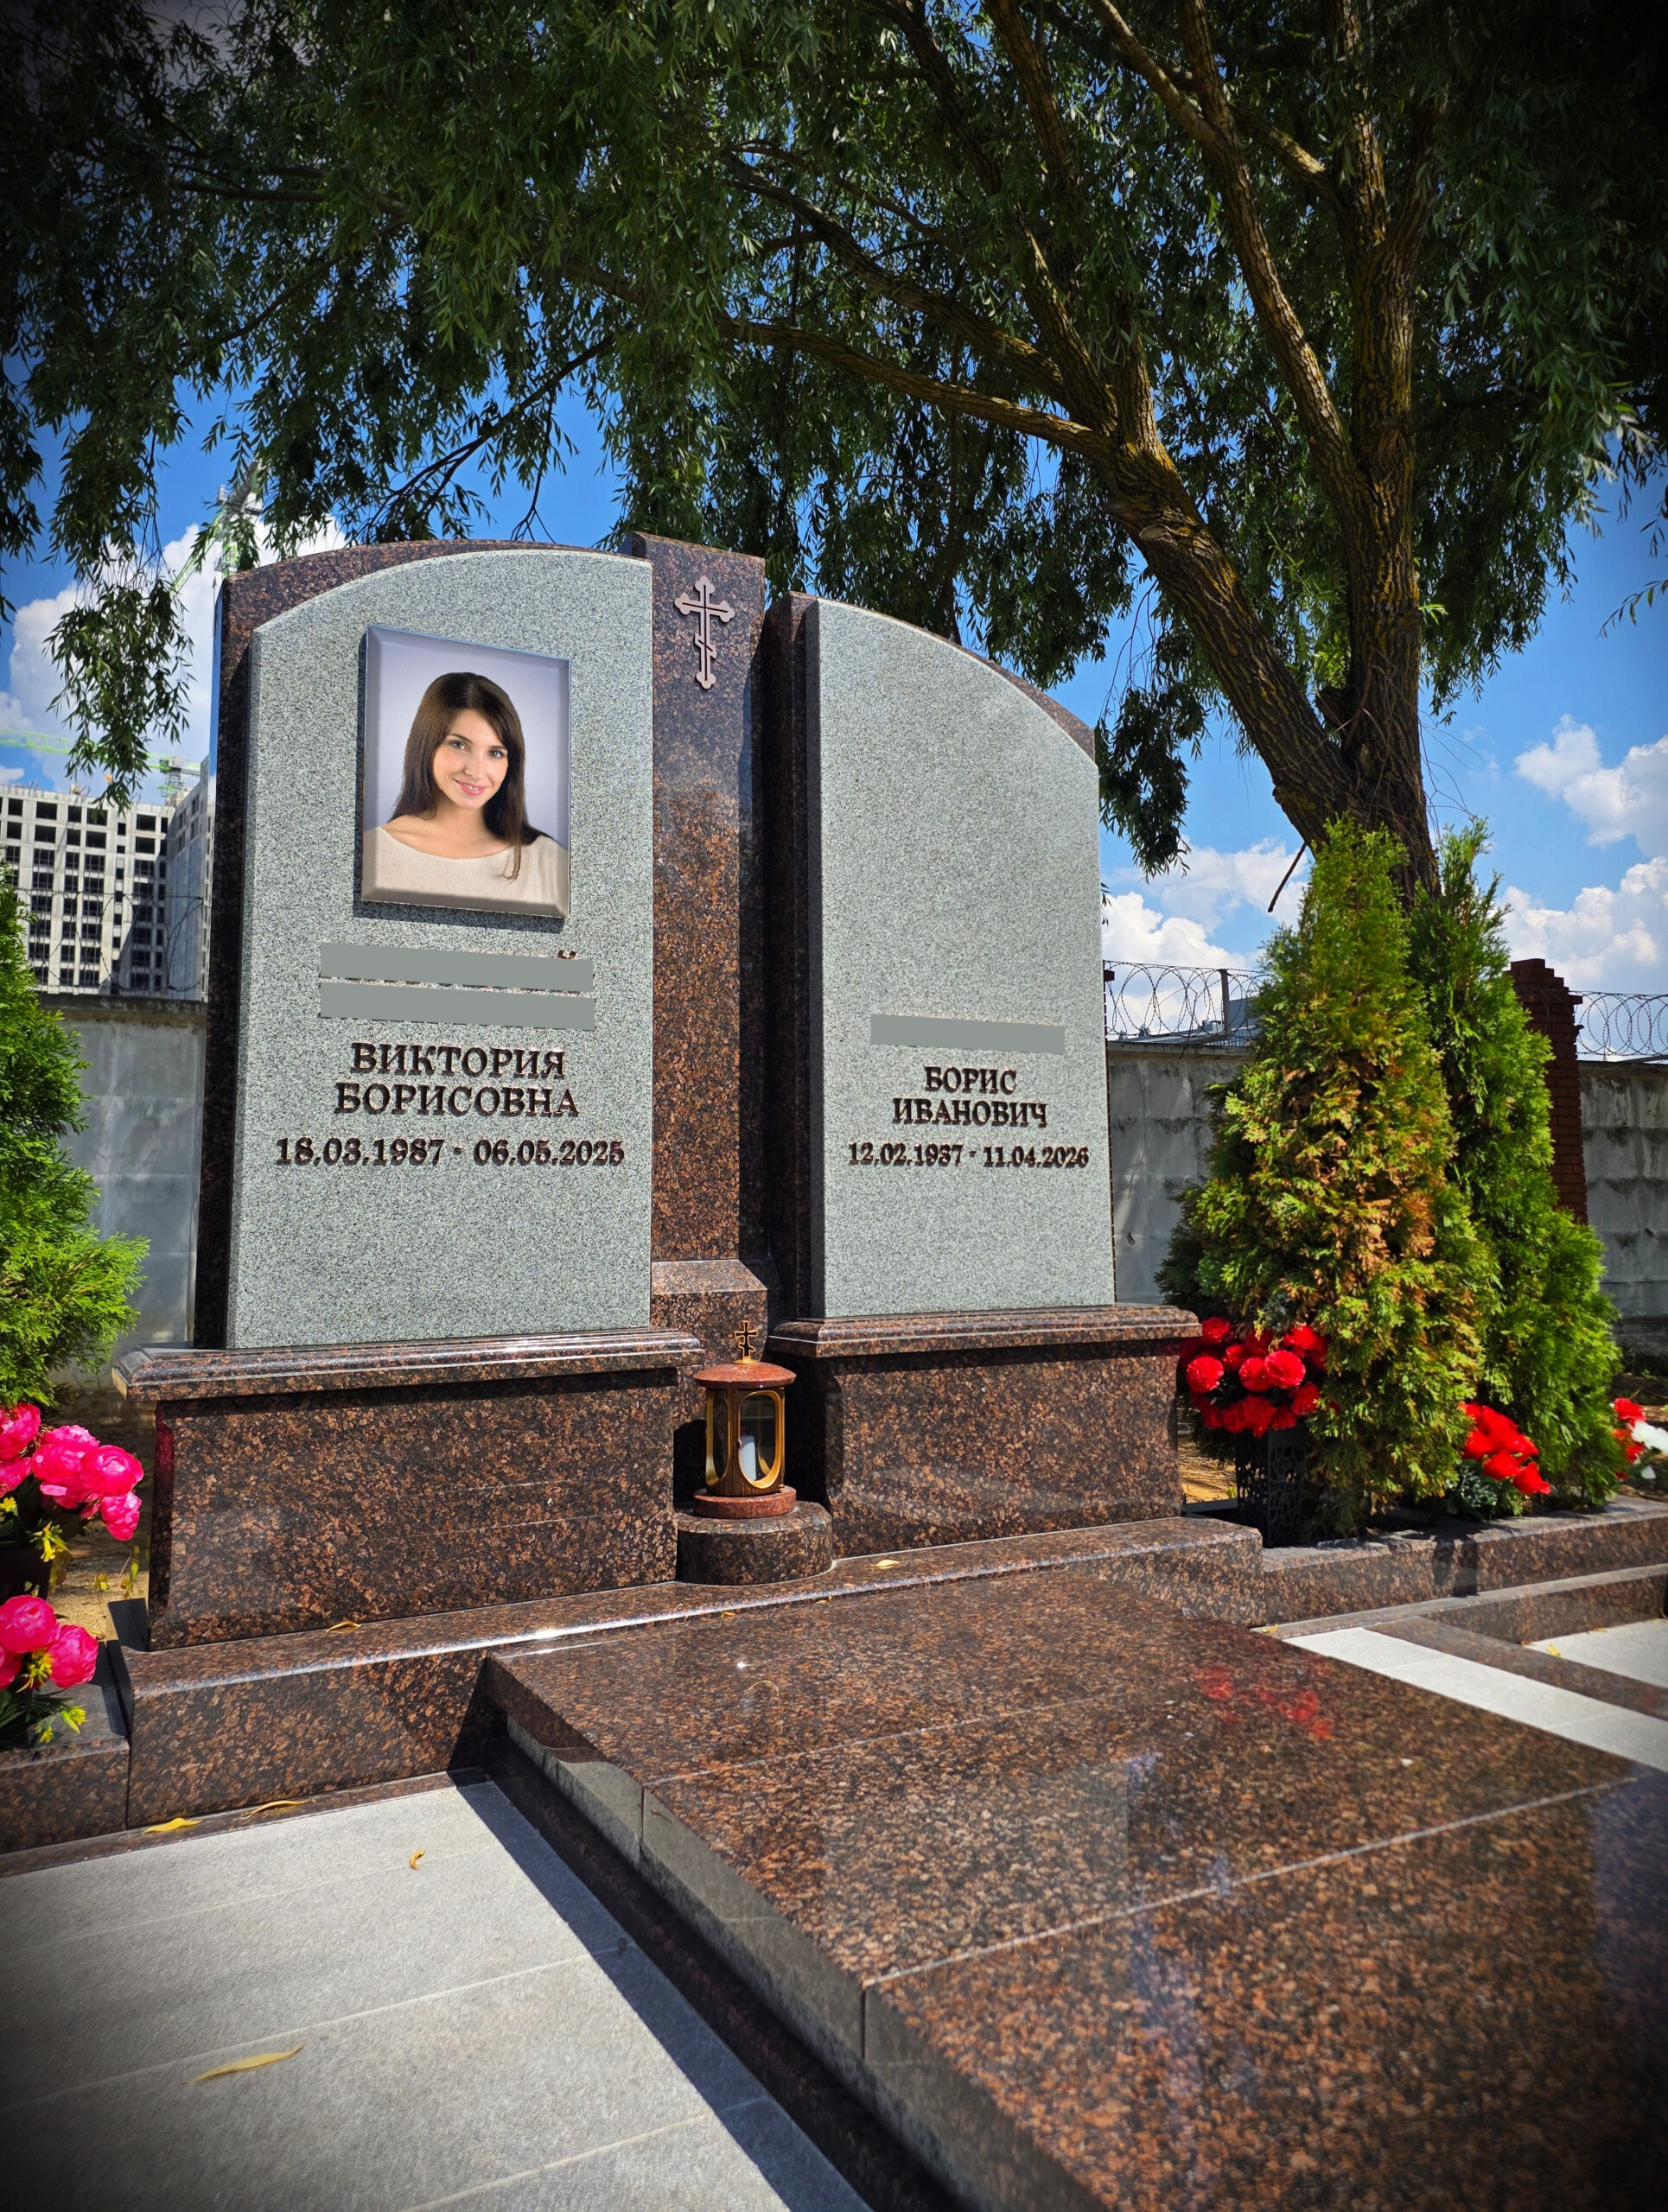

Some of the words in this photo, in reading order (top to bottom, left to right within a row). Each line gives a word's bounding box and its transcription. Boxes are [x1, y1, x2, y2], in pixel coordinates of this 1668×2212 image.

[350, 1041, 567, 1079] ВИКТОРИЯ
[924, 1065, 1017, 1095] БОРИС
[334, 1082, 580, 1117] БОРИСОВНА
[892, 1097, 1047, 1128] ИВАНОВИЧ
[276, 1137, 445, 1166] 18.03.1987
[473, 1139, 625, 1166] 06.05.2025
[984, 1144, 1089, 1168] 11.04.2026
